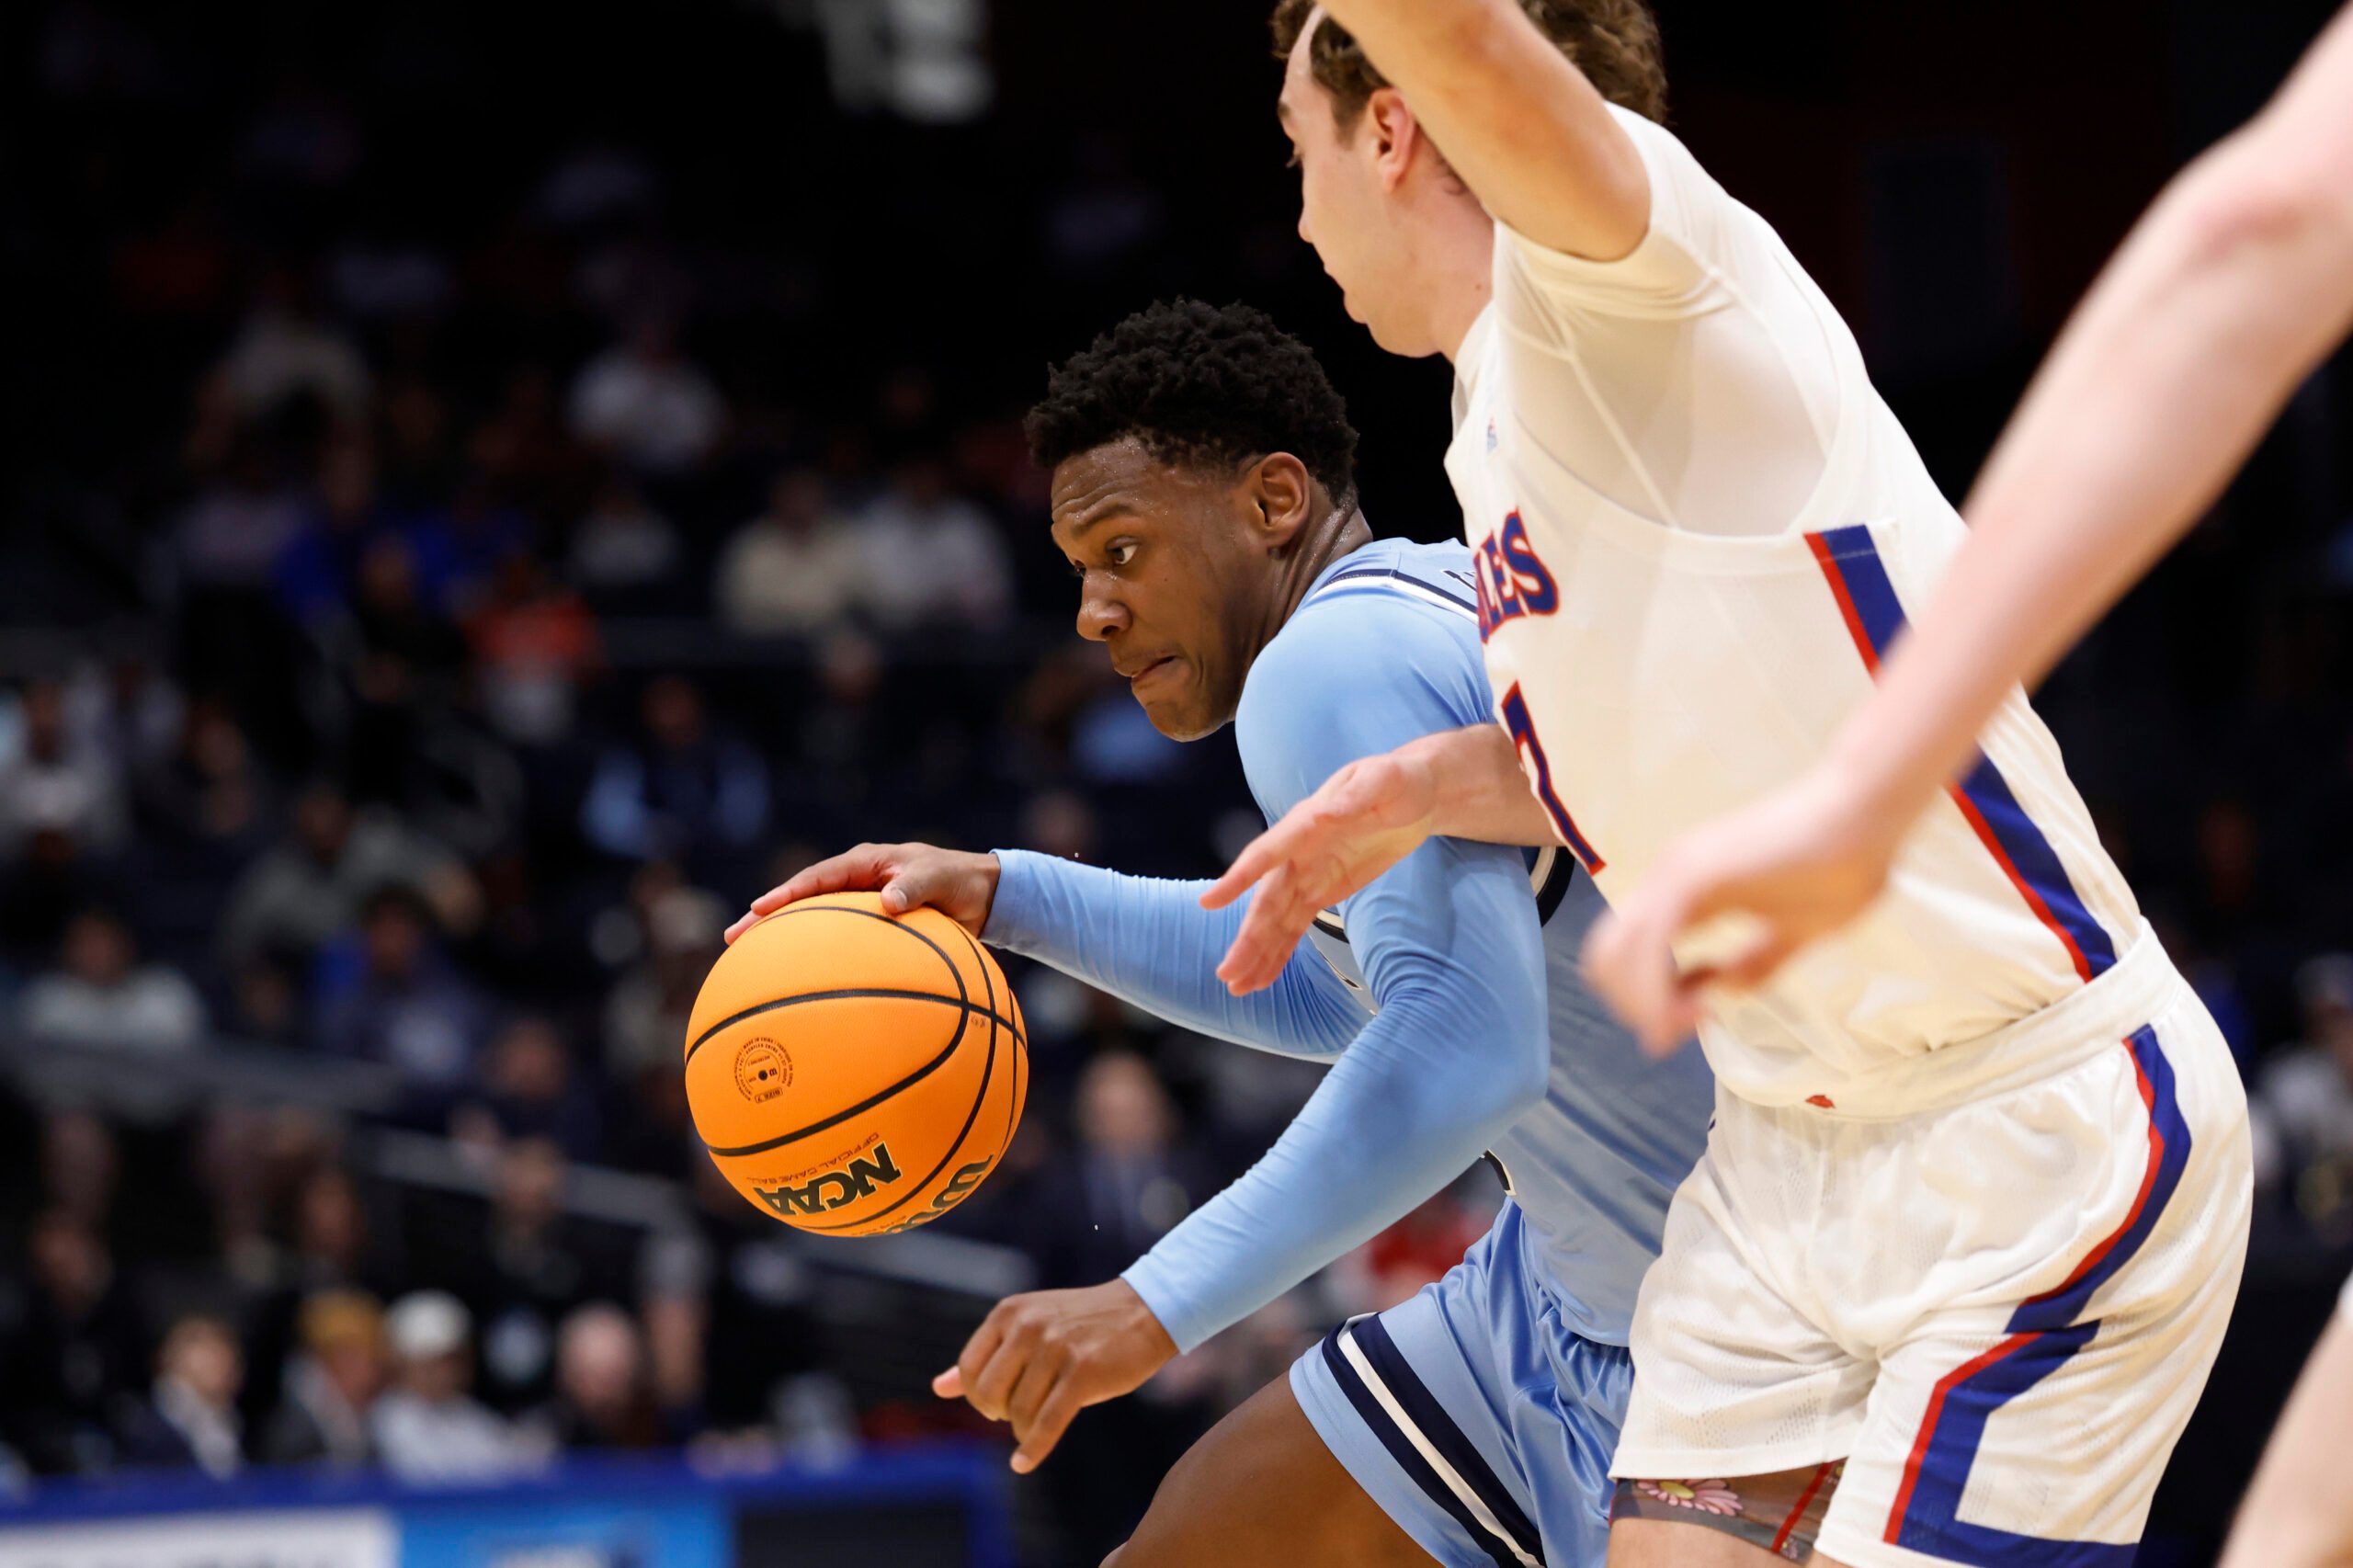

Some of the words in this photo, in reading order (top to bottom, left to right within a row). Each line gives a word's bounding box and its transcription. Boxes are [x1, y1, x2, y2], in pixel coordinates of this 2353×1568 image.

[819, 1131, 881, 1169] OFFICIAL
[753, 1142, 902, 1216] NCAA
[779, 1167, 818, 1184] GAME
